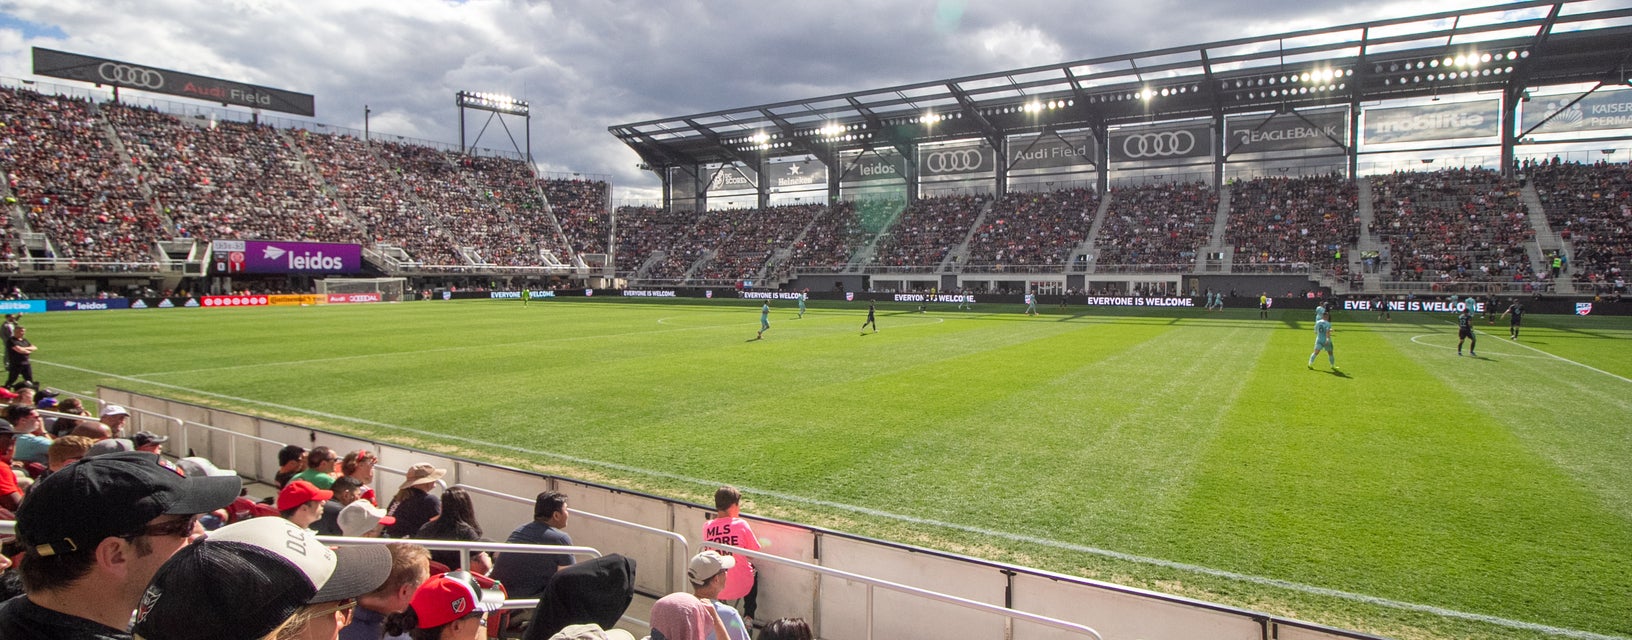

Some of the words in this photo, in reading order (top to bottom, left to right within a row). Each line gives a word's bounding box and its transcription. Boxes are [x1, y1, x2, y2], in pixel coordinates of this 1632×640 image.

[183, 82, 226, 98] Audi
[230, 89, 271, 105] Field
[1592, 102, 1632, 114] KAISER
[1377, 113, 1483, 132] mobilitie
[1015, 148, 1048, 161] Audi
[1051, 144, 1086, 158] Field
[860, 162, 896, 176] leidos
[778, 176, 813, 186] Heineken
[288, 251, 343, 270] leidos
[490, 291, 521, 299] EVERYONE
[744, 291, 772, 299] EVERYONE
[779, 292, 809, 300] WELCOE.
[938, 294, 977, 303] WELCOE.
[77, 302, 107, 310] leidos
[1087, 296, 1133, 306] EVERYONE
[1134, 297, 1144, 306] IS
[1145, 297, 1195, 307] WELCOME.
[1407, 301, 1420, 311] IS
[706, 524, 731, 538] MLS
